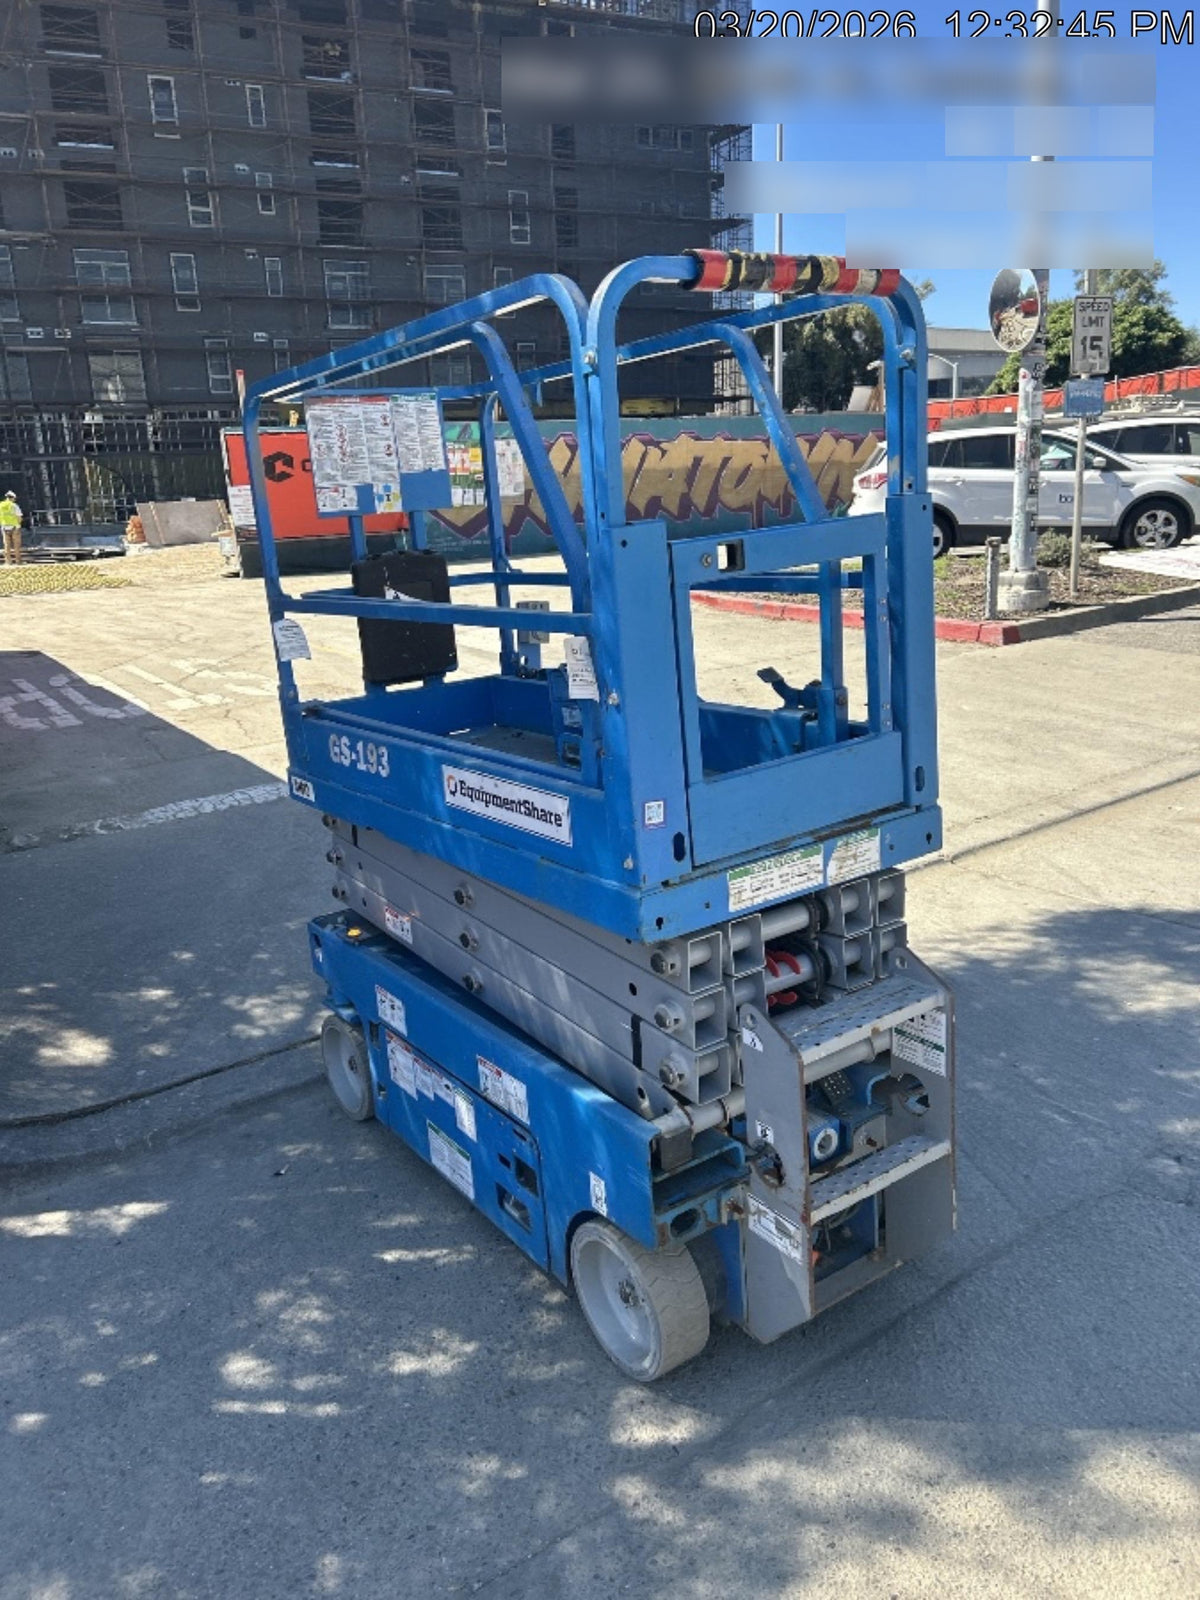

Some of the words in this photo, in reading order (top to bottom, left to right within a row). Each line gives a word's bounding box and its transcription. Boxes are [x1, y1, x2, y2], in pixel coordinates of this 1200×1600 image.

[1078, 301, 1110, 312] SPEED
[1081, 315, 1105, 328] LIMIT
[1080, 335, 1104, 361] 15
[328, 733, 391, 778] GS-193
[458, 779, 563, 828] EquipmentShare
